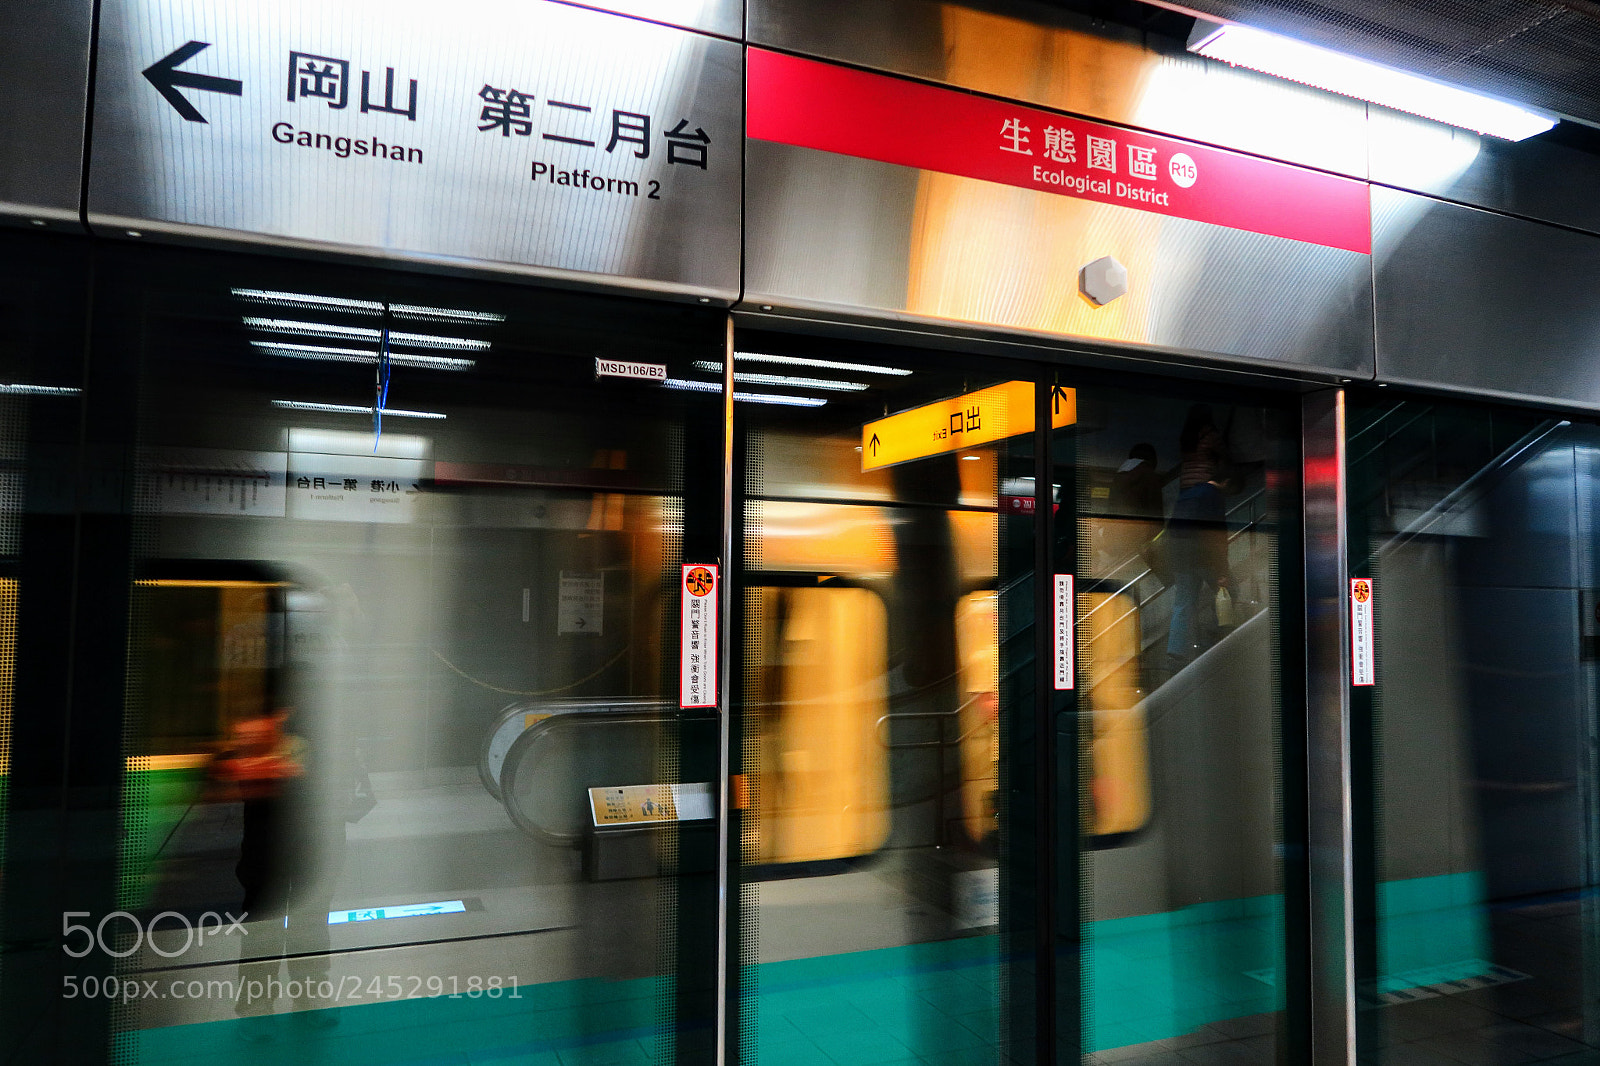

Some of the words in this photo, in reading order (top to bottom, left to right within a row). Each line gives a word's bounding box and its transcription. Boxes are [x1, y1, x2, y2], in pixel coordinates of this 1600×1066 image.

[287, 50, 418, 121] 岡山
[271, 122, 423, 164] Gangshan
[477, 84, 711, 170] 第二月台
[999, 118, 1158, 181] 生態園區
[531, 161, 639, 197] Platform
[647, 180, 661, 199] 2
[1033, 165, 1111, 195] Ecological
[1116, 182, 1170, 206] District
[1171, 162, 1196, 179] R15
[600, 362, 664, 377] MSD106/B2
